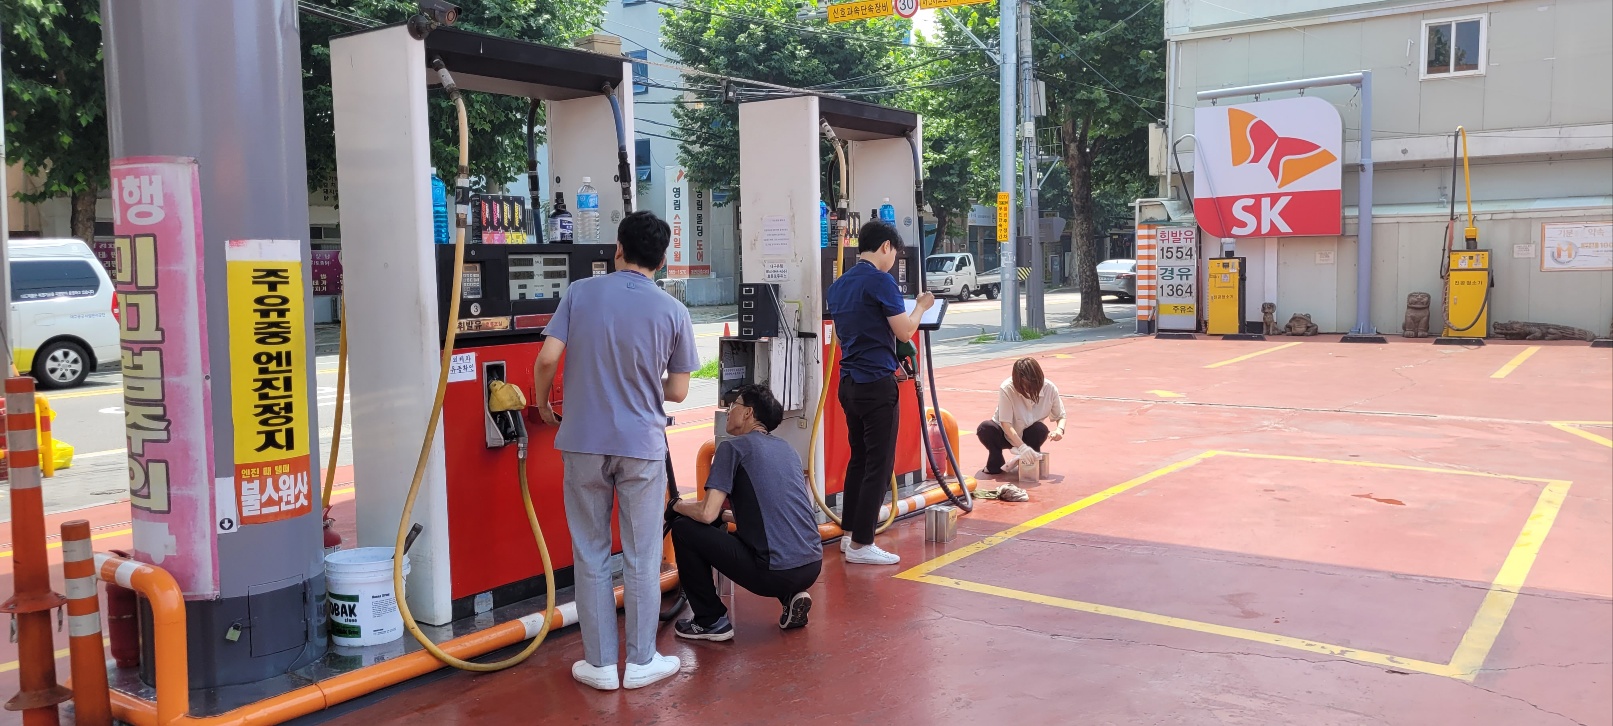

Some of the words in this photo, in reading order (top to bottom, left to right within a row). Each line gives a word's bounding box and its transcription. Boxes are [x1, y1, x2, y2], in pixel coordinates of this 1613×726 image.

[832, 2, 889, 18] 신호과속단속장비
[900, 0, 914, 10] 30
[1231, 195, 1293, 236] SK
[1159, 230, 1194, 244] 휘발유
[1160, 246, 1193, 260] 1554
[1159, 268, 1193, 281] 경유
[1160, 284, 1193, 297] 1364
[251, 268, 292, 346] 주유중
[1172, 305, 1194, 314] 주유소
[457, 320, 483, 331] 휘발유
[252, 350, 295, 453] 엔진정지
[241, 467, 260, 478] 엔진
[241, 470, 308, 517] 불스원샷
